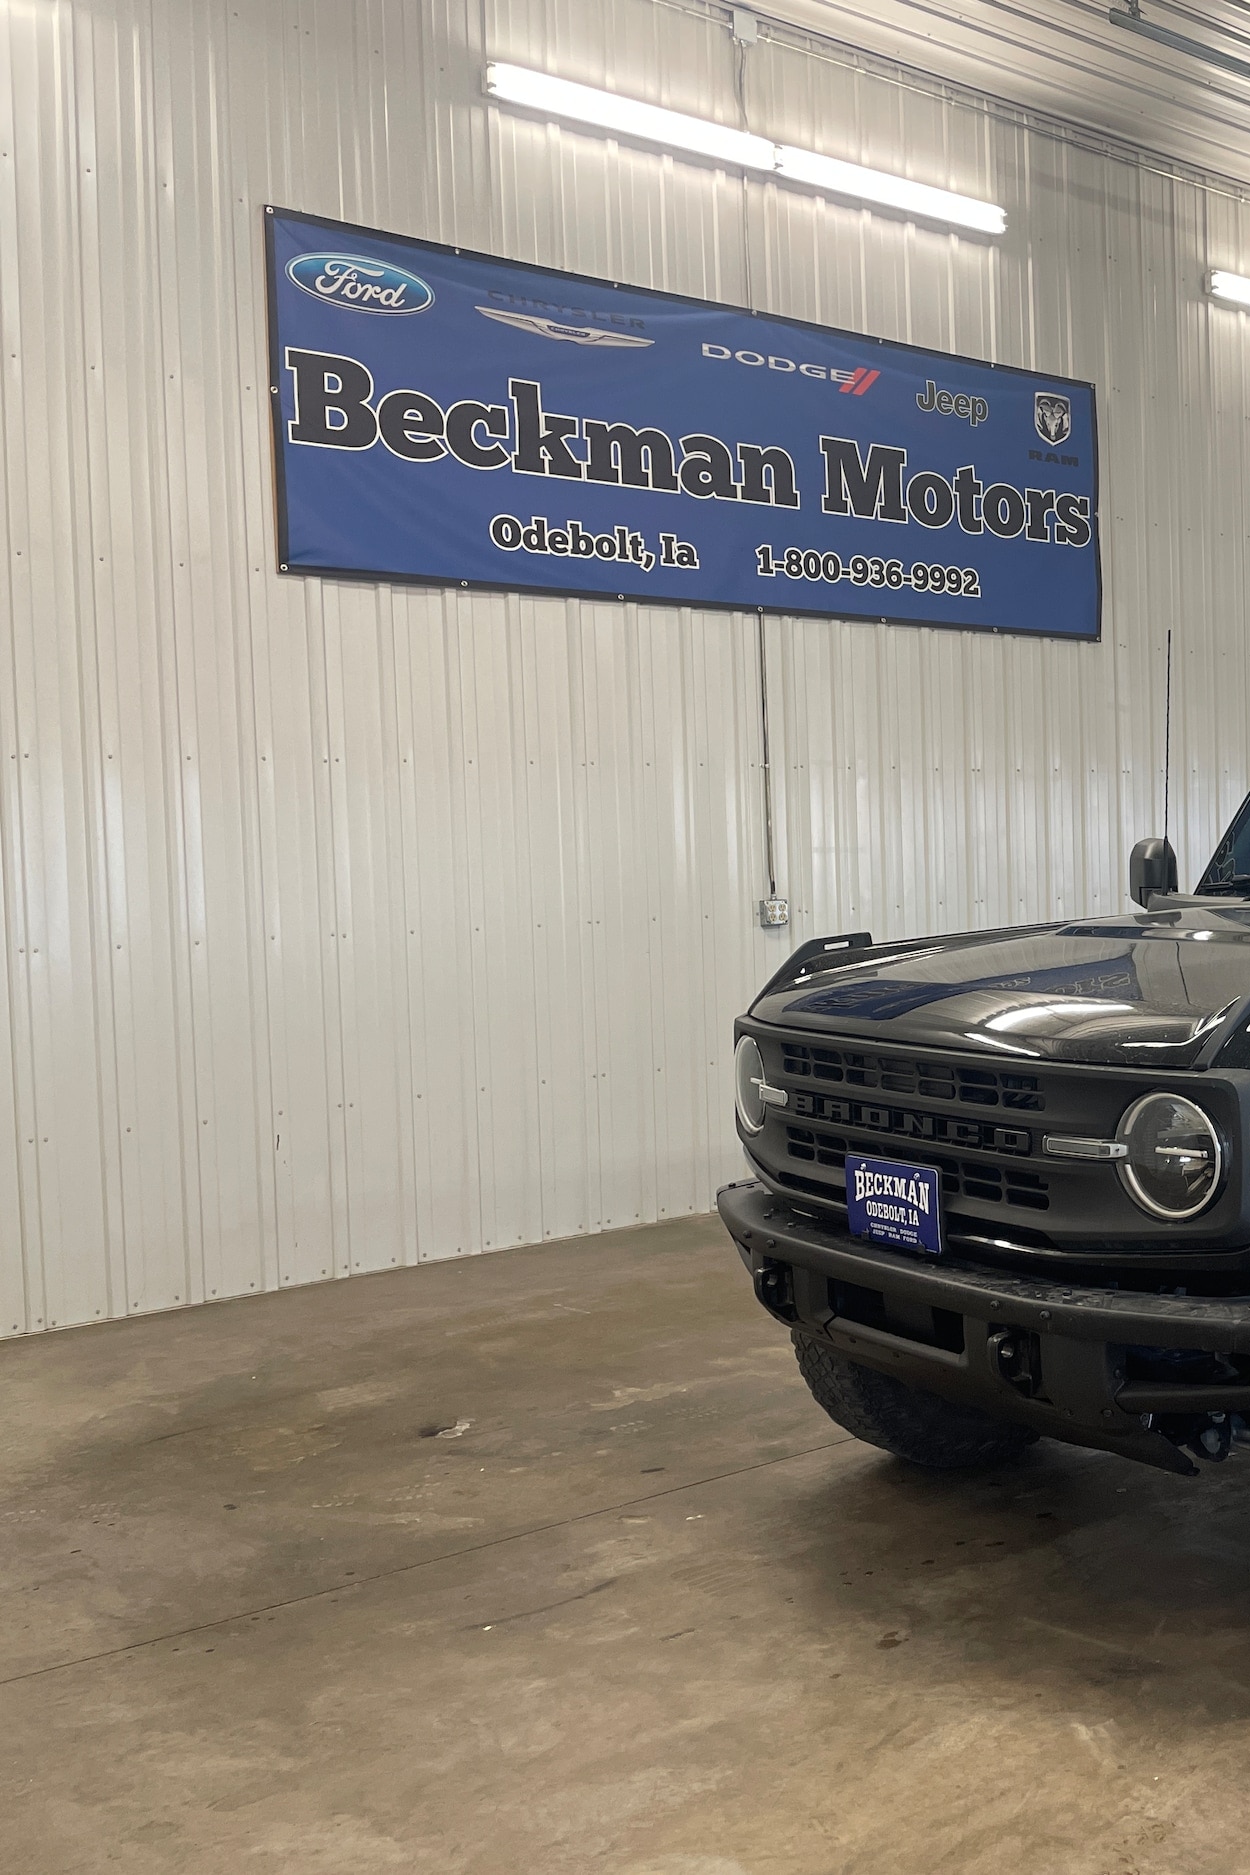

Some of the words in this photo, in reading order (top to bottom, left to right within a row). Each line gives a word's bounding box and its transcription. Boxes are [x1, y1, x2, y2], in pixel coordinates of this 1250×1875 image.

[314, 259, 405, 308] Ford
[487, 289, 645, 330] CHRYSLER
[702, 343, 856, 384] DODGE
[916, 380, 989, 427] Jeep
[285, 346, 801, 510] Beckman
[819, 434, 1091, 548] Motors
[1028, 450, 1079, 467] RAM
[489, 513, 655, 572] Odebolt,
[660, 532, 700, 570] Ia
[755, 544, 981, 598] 1-800-936-9992
[790, 1092, 1031, 1151] BRONCO
[854, 1169, 930, 1215] BECKMAN
[866, 1200, 906, 1226] ODEBOLT,
[908, 1209, 920, 1226] IA
[888, 1232, 901, 1240] RAM
